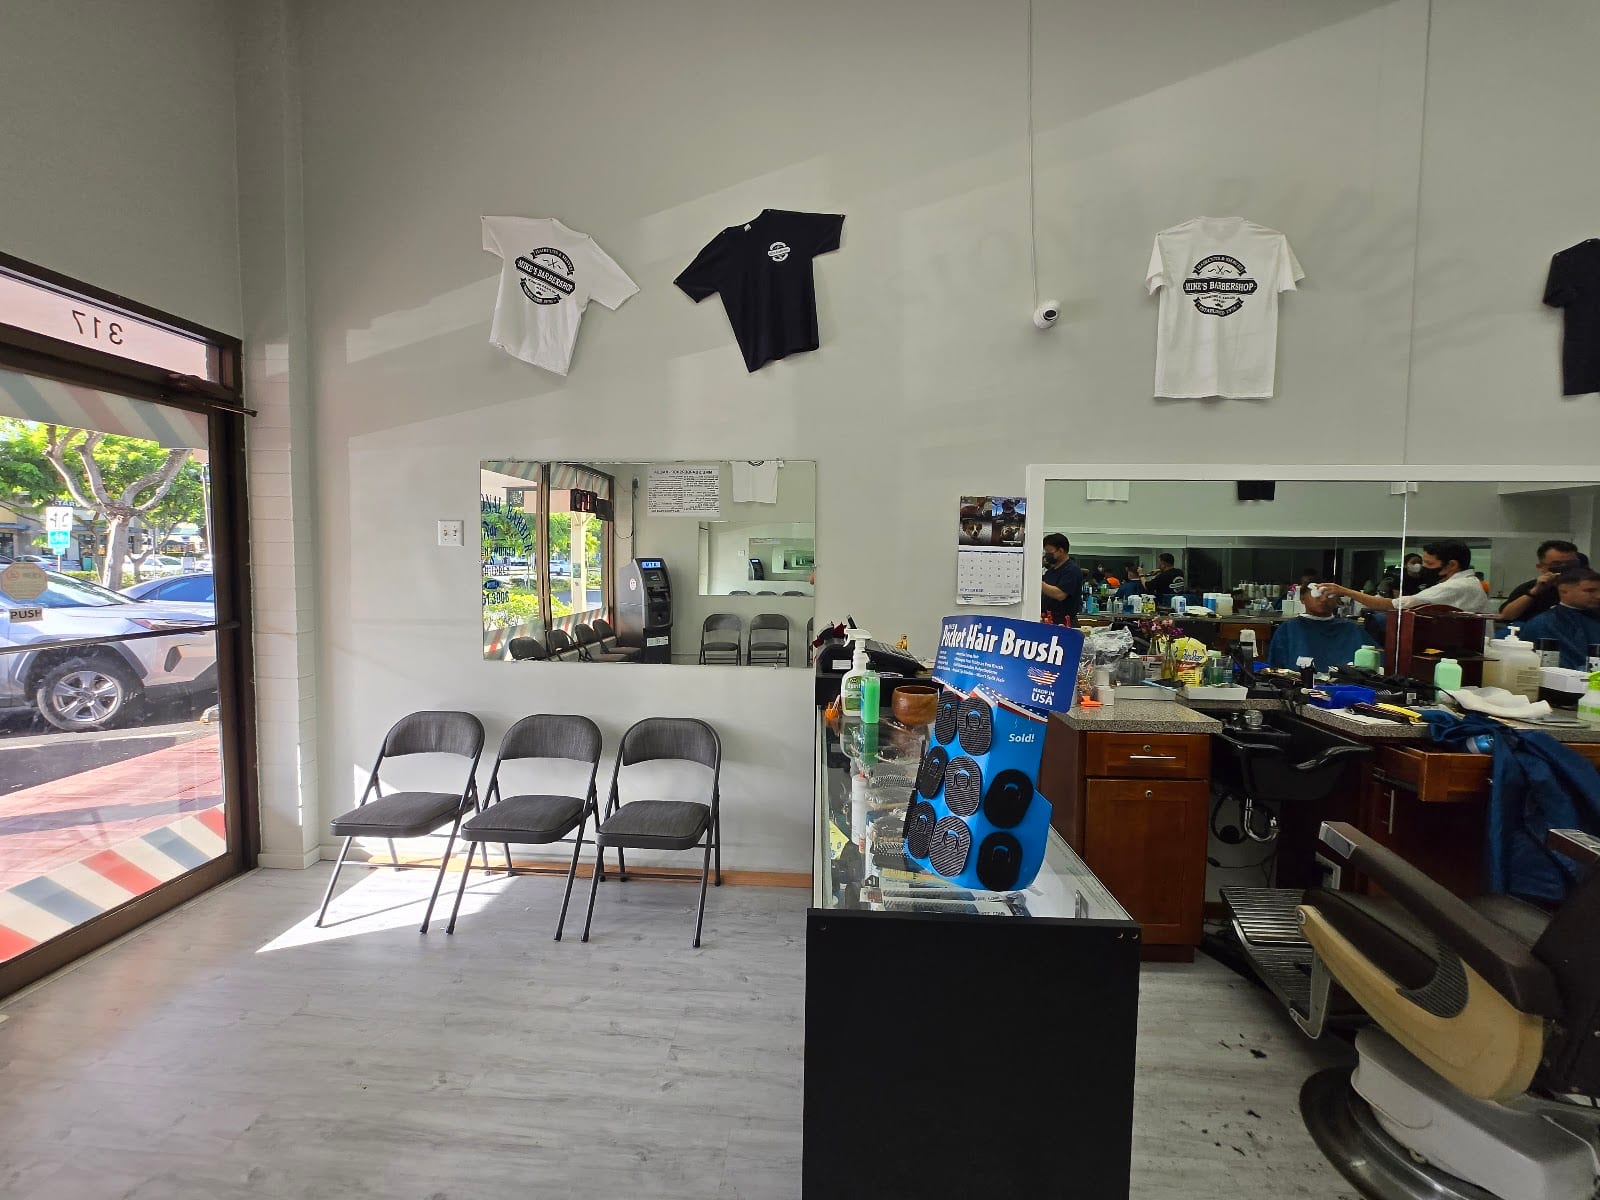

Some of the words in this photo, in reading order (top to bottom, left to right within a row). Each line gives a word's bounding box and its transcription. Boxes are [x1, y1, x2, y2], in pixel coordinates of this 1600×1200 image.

[518, 260, 538, 275] MIKE'S
[537, 269, 573, 291] BARBERSHOP
[1185, 282, 1208, 291] MIKE'S
[1209, 281, 1254, 292] BARBERSHOP
[506, 503, 533, 553] BARBER
[10, 609, 42, 620] PUSH
[941, 624, 967, 648] Pocket
[966, 624, 999, 653] Hair
[1000, 628, 1064, 666] Brush
[1033, 687, 1048, 695] MADE
[1031, 692, 1053, 706] USA
[1008, 733, 1035, 743] Sold!
